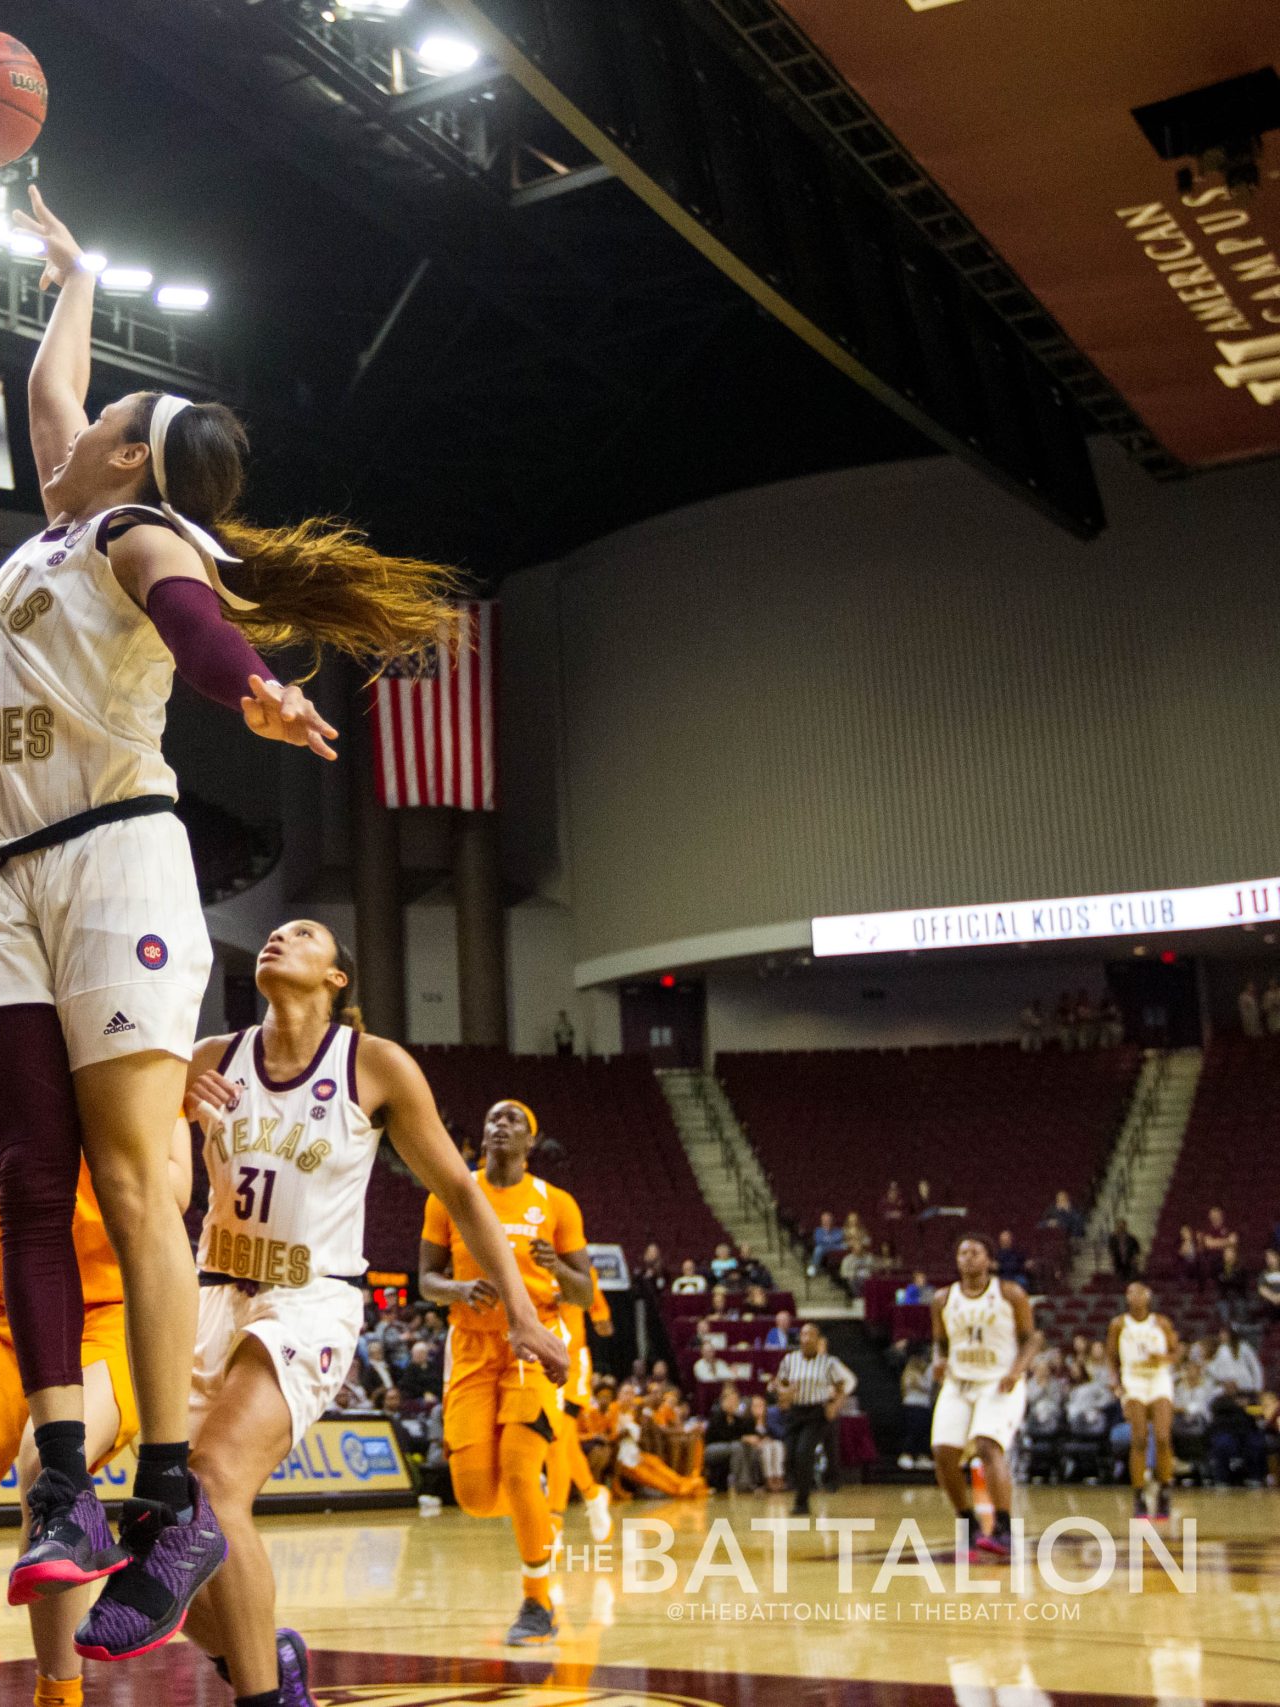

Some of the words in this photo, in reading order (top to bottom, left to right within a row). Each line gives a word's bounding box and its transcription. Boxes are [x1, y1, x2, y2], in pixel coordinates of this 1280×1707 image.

[1116, 201, 1253, 332] AMERICAN
[912, 910, 1019, 945] OFFICIAL
[1110, 896, 1176, 931] CLUB
[104, 1023, 136, 1035] adidas
[211, 1116, 332, 1174] TEXAS
[234, 1165, 277, 1224] 31
[205, 1223, 311, 1289] AGGIES
